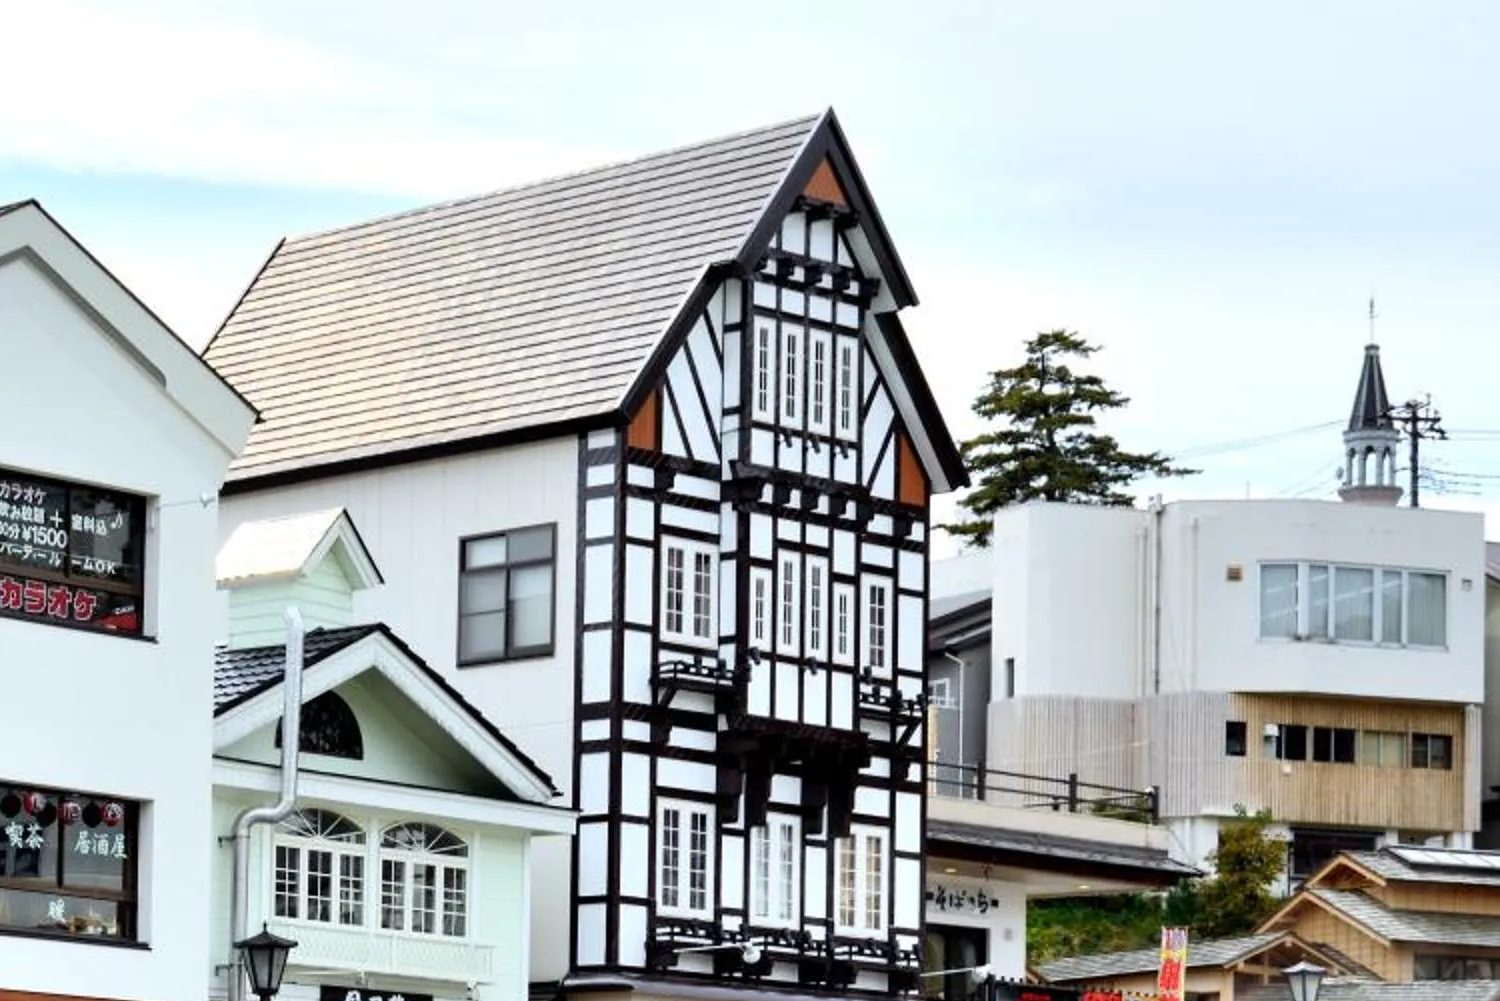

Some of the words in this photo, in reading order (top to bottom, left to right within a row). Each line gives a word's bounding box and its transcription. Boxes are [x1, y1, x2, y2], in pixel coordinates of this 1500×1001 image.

[0, 576, 98, 622] カラオケ
[5, 821, 44, 849] 喫茶
[74, 830, 128, 859] 居酒屋
